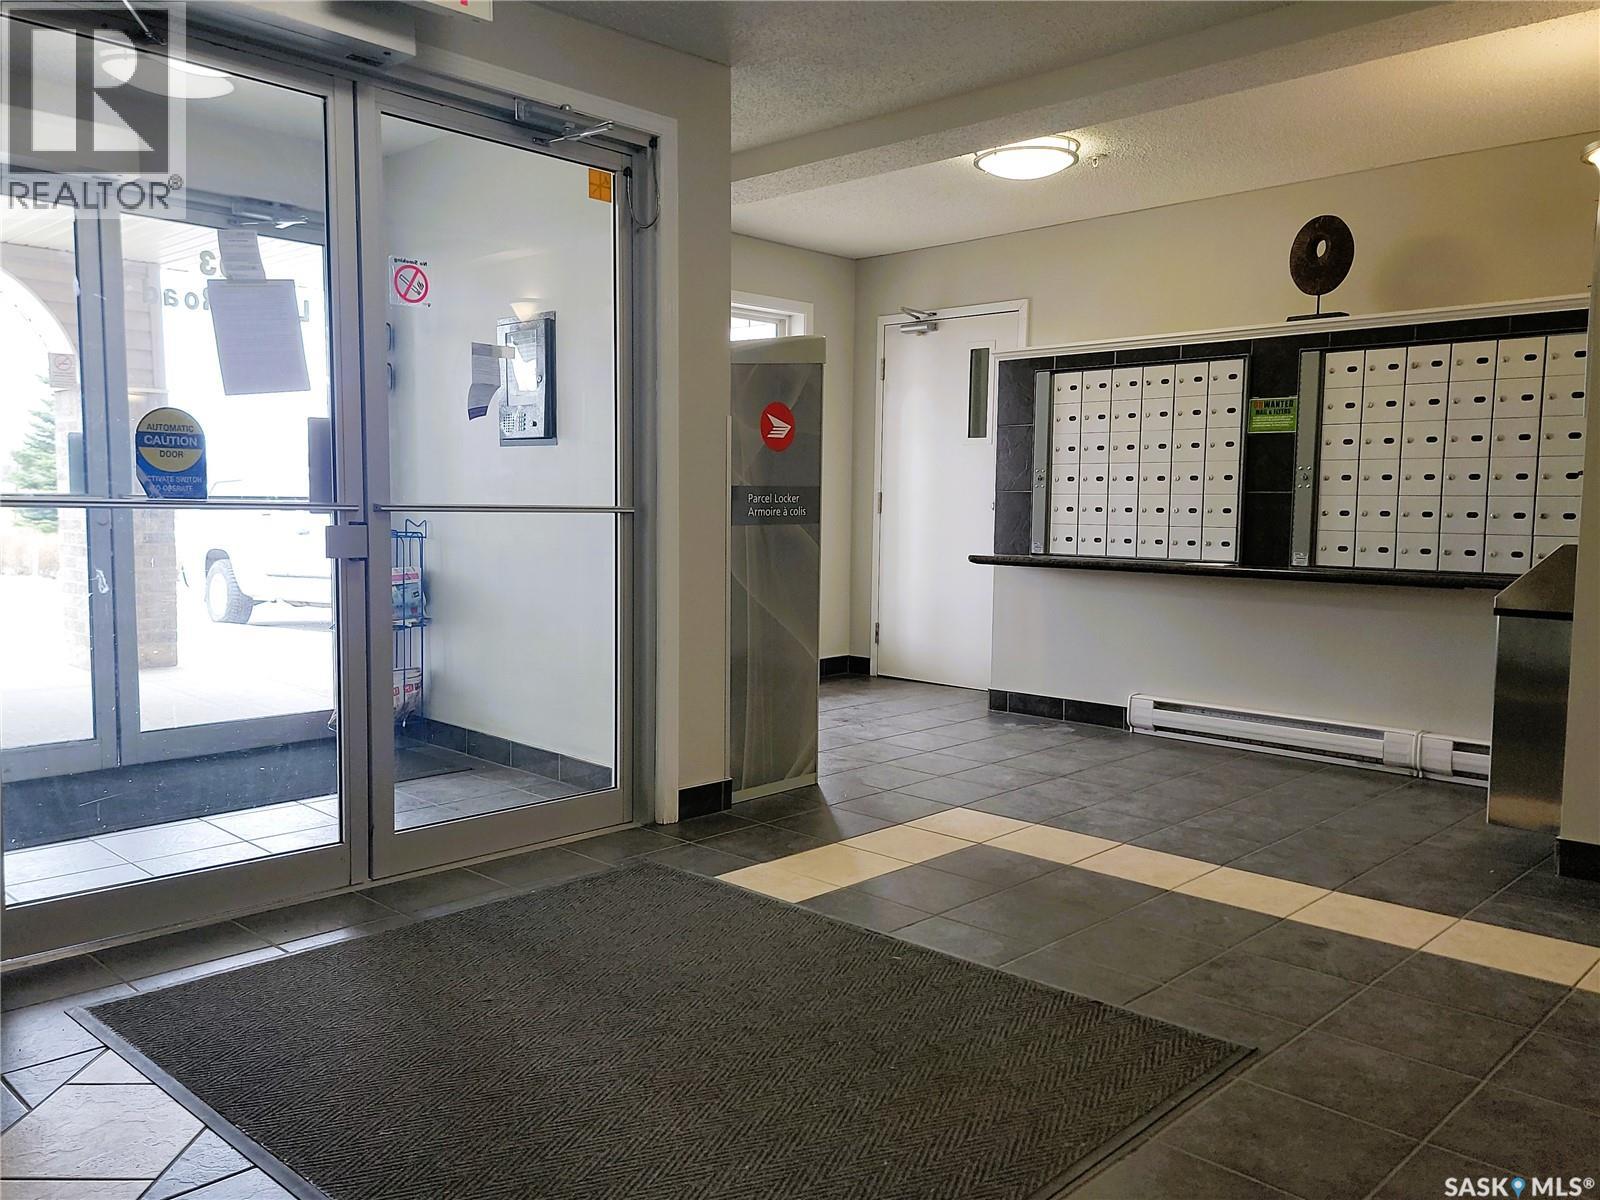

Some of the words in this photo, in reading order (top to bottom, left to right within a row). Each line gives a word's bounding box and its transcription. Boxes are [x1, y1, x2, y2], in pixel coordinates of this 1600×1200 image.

[146, 423, 194, 432] AUTOMATIC
[143, 435, 198, 447] CAUTION
[159, 450, 184, 458] DOOR
[747, 493, 772, 504] Parcel
[774, 493, 800, 504] Locker
[747, 506, 781, 517] Armoire
[783, 506, 788, 516] à
[789, 505, 806, 516] colis
